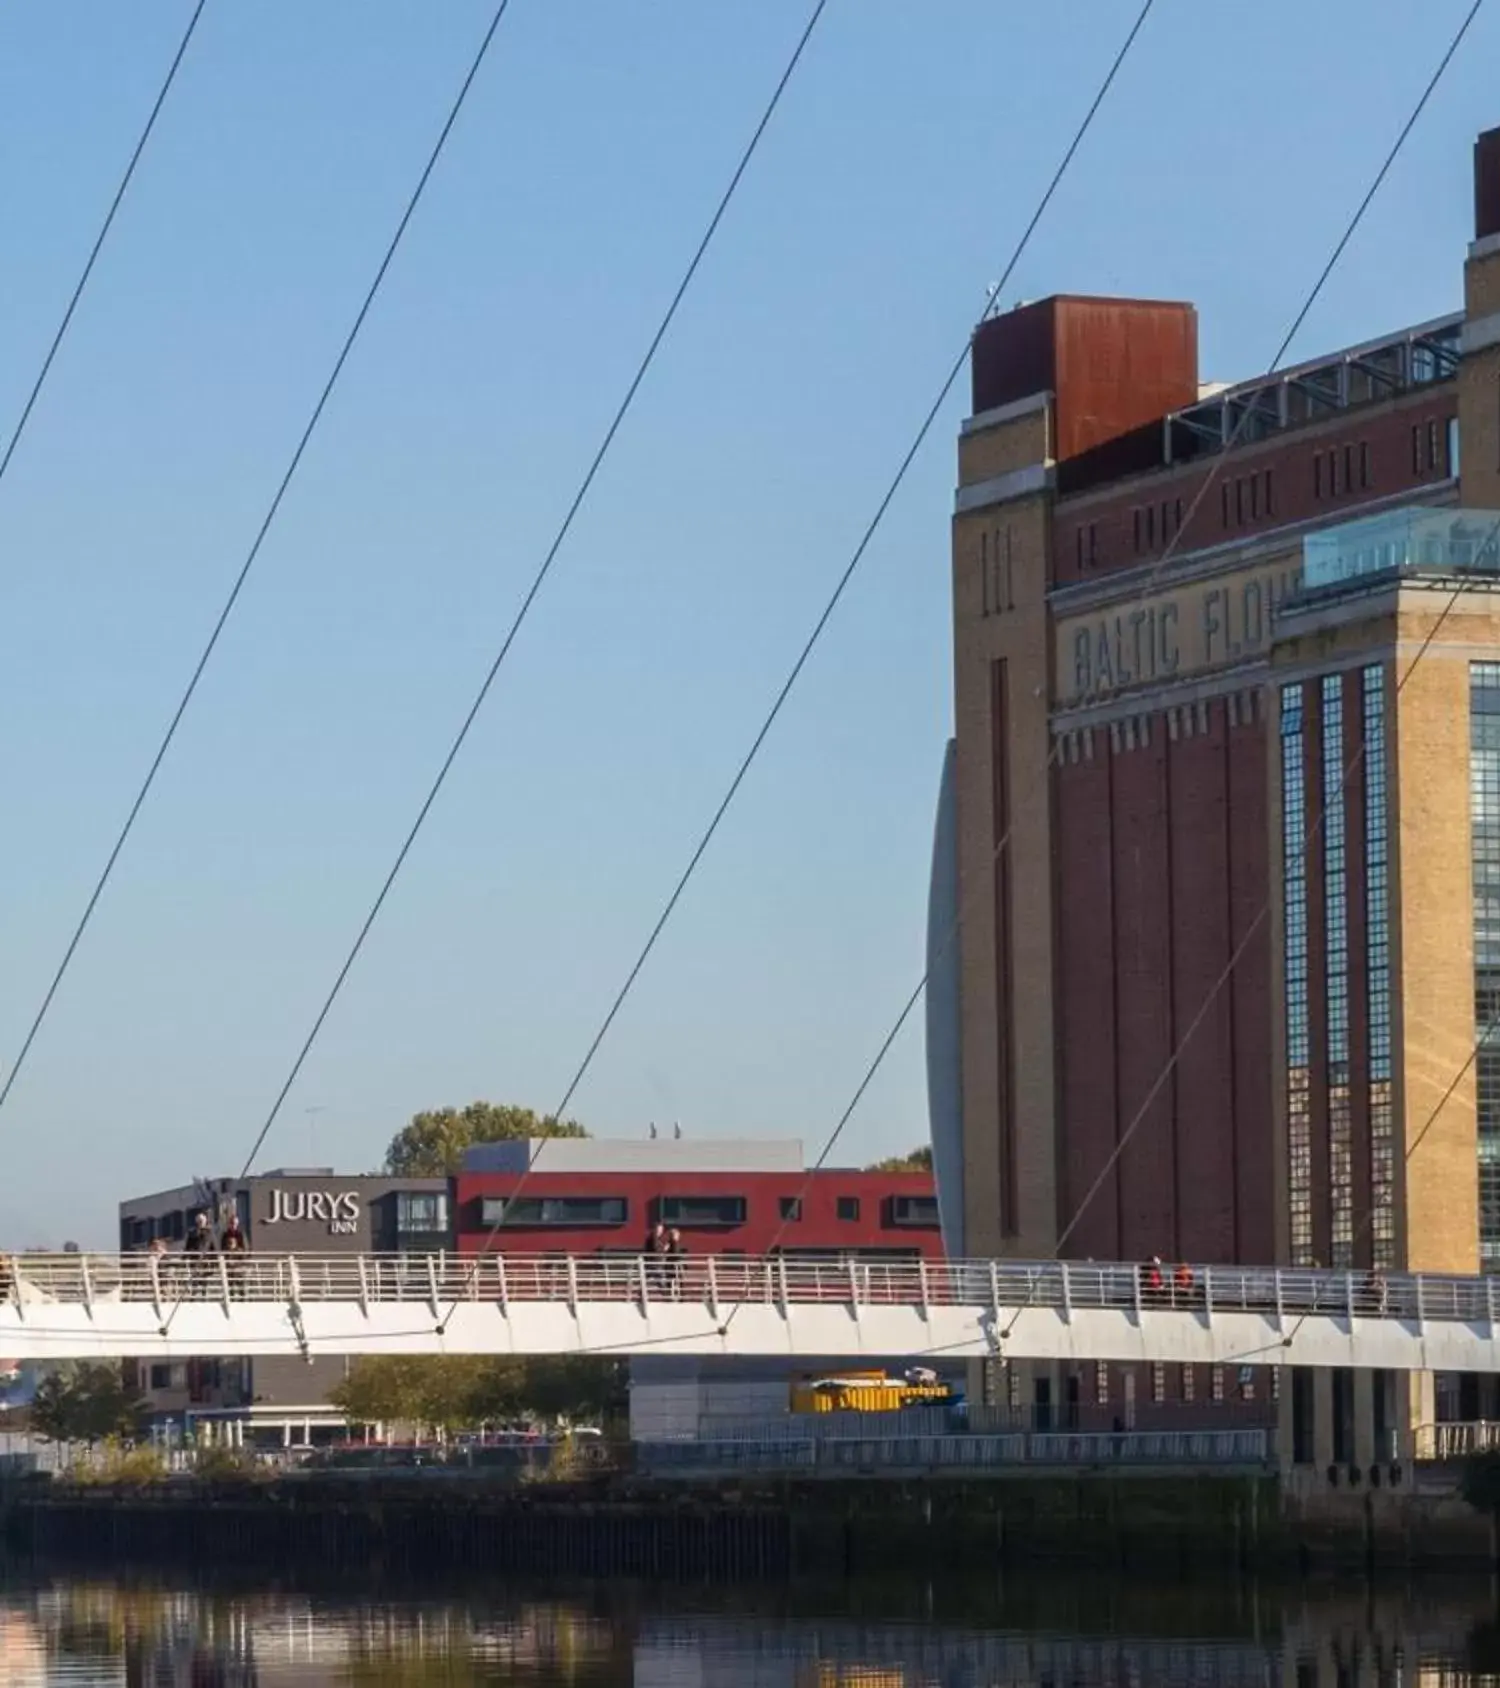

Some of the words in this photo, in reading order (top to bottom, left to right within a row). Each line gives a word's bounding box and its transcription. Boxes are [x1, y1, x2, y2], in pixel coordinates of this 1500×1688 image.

[1073, 602, 1179, 692] BALTIC
[264, 1189, 359, 1224] JURYS
[330, 1222, 357, 1233] INN
